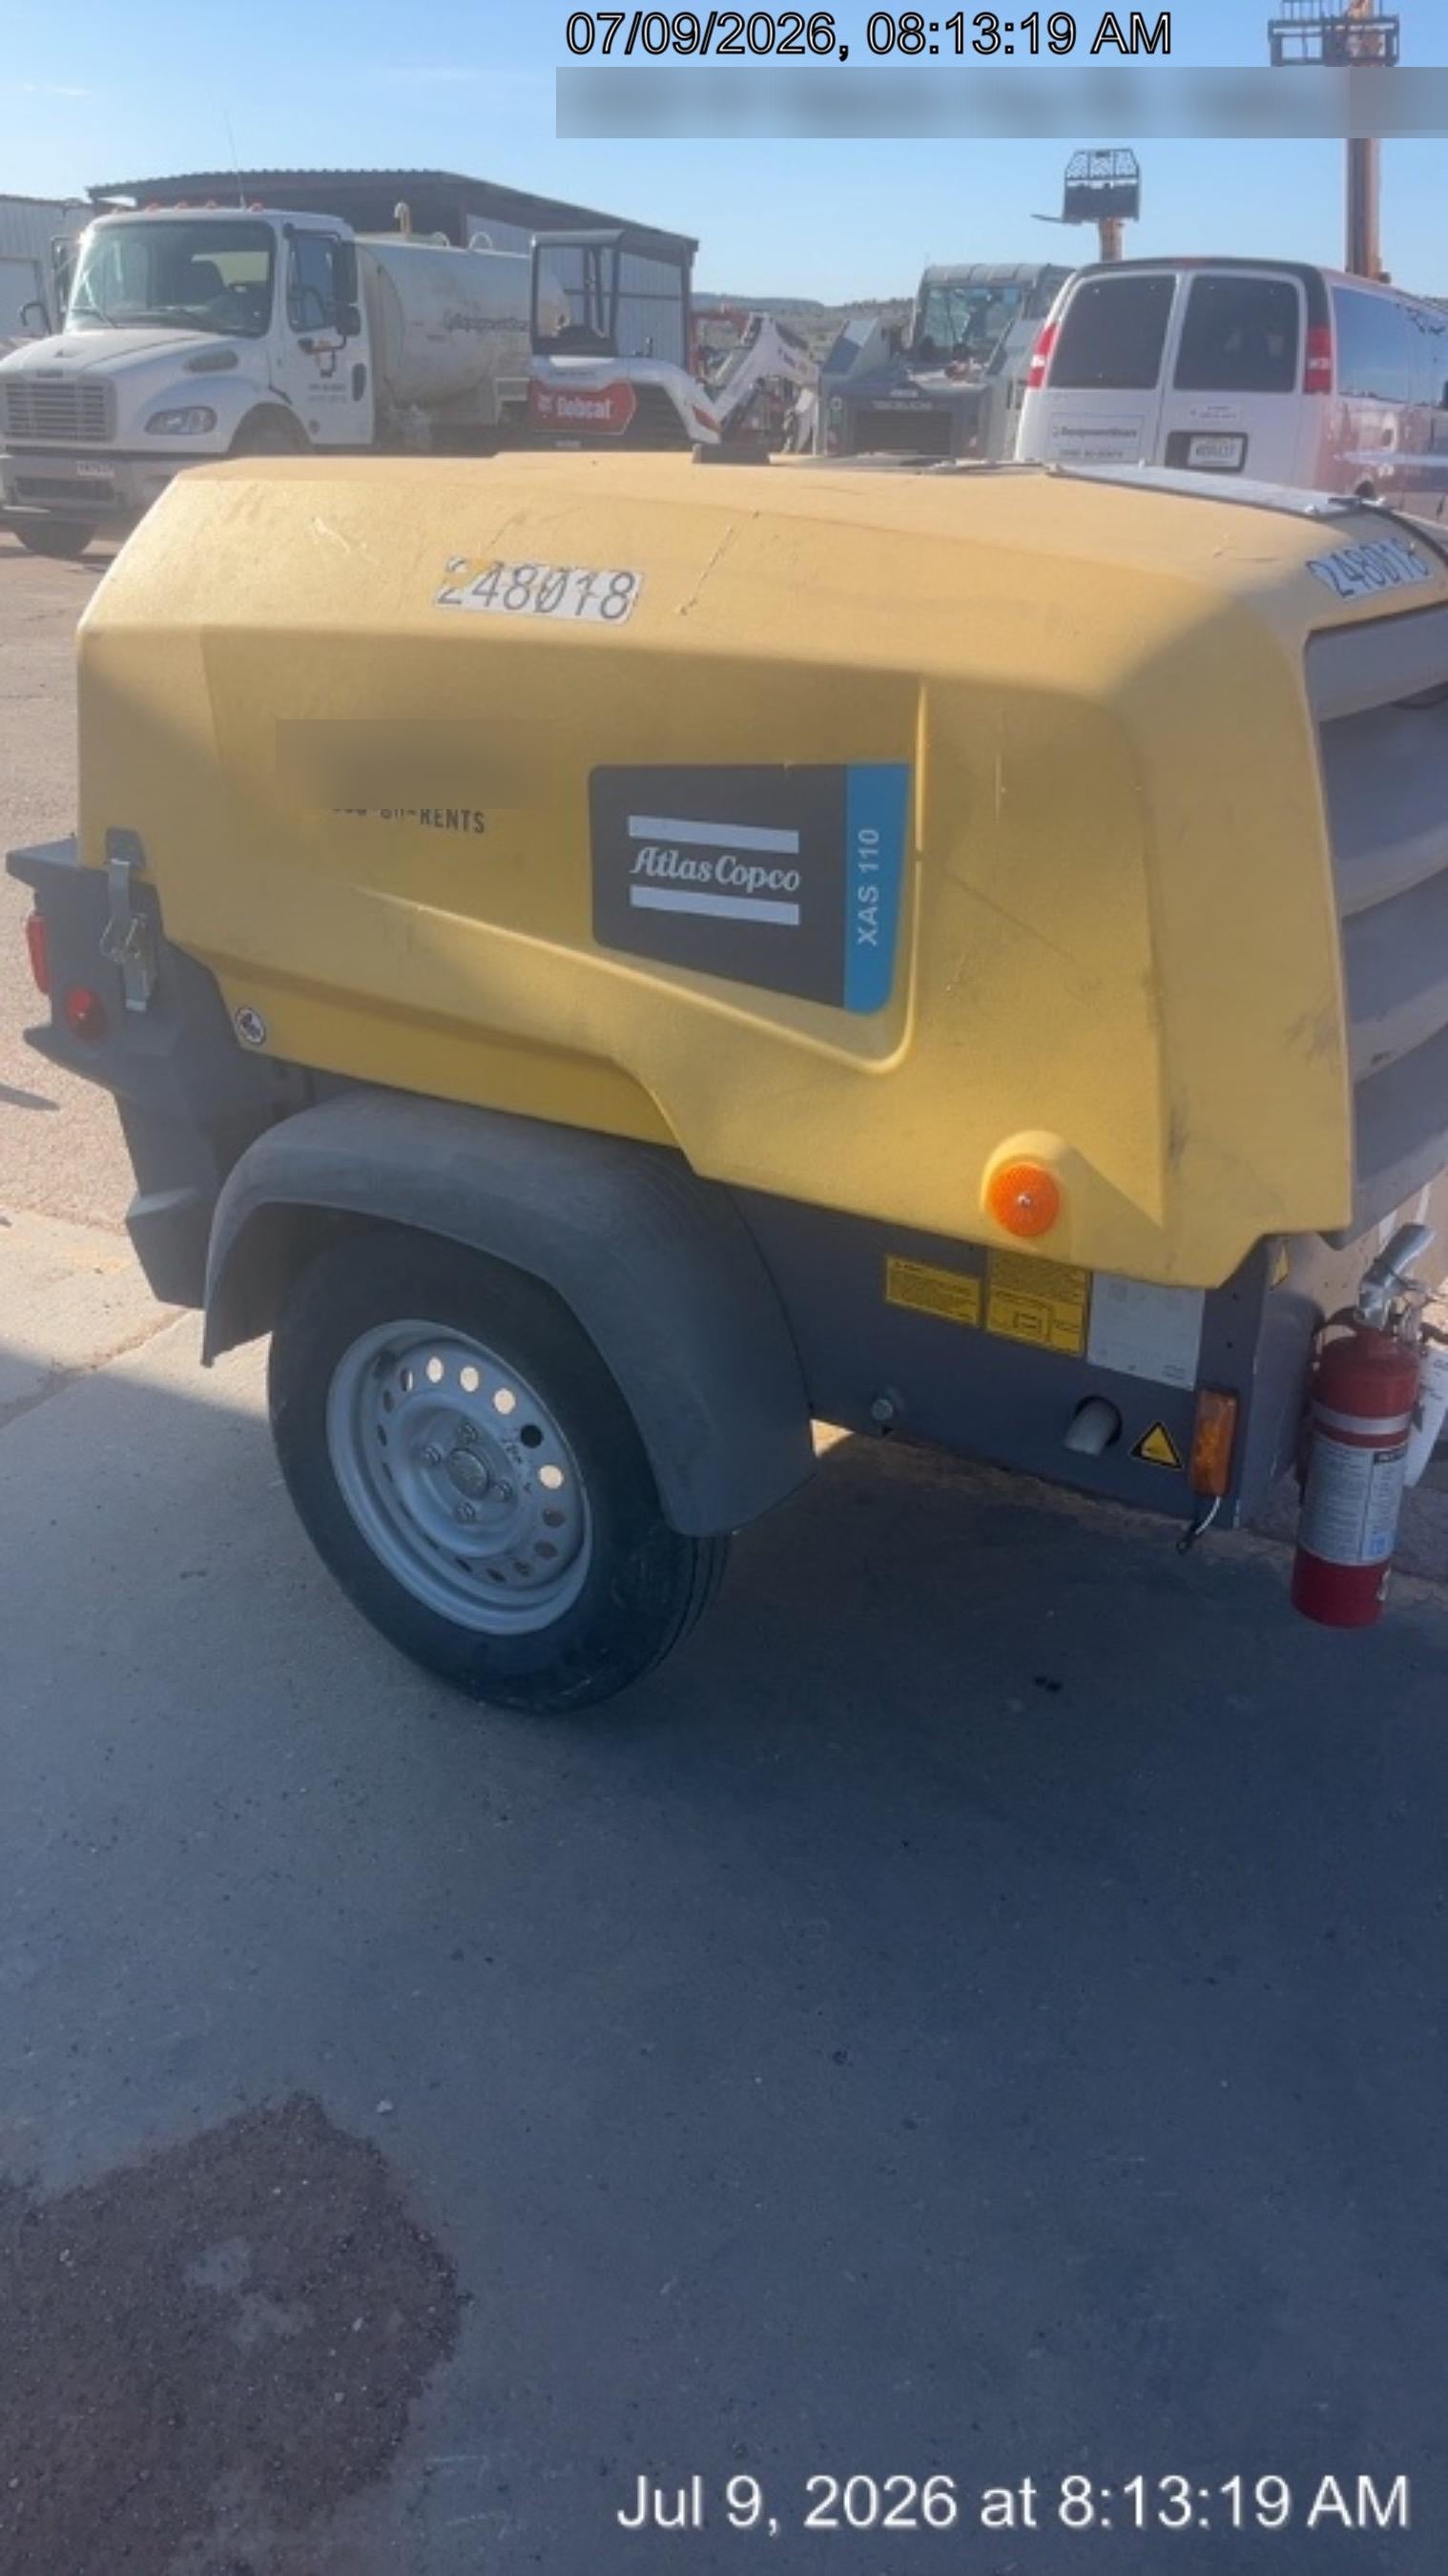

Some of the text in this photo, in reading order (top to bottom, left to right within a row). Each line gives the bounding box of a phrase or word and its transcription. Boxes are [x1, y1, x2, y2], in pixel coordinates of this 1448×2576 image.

[556, 396, 614, 420] Bobcat
[436, 555, 637, 620] 248018
[630, 845, 801, 894] Atlas Copco
[858, 828, 879, 946] XAS 110
